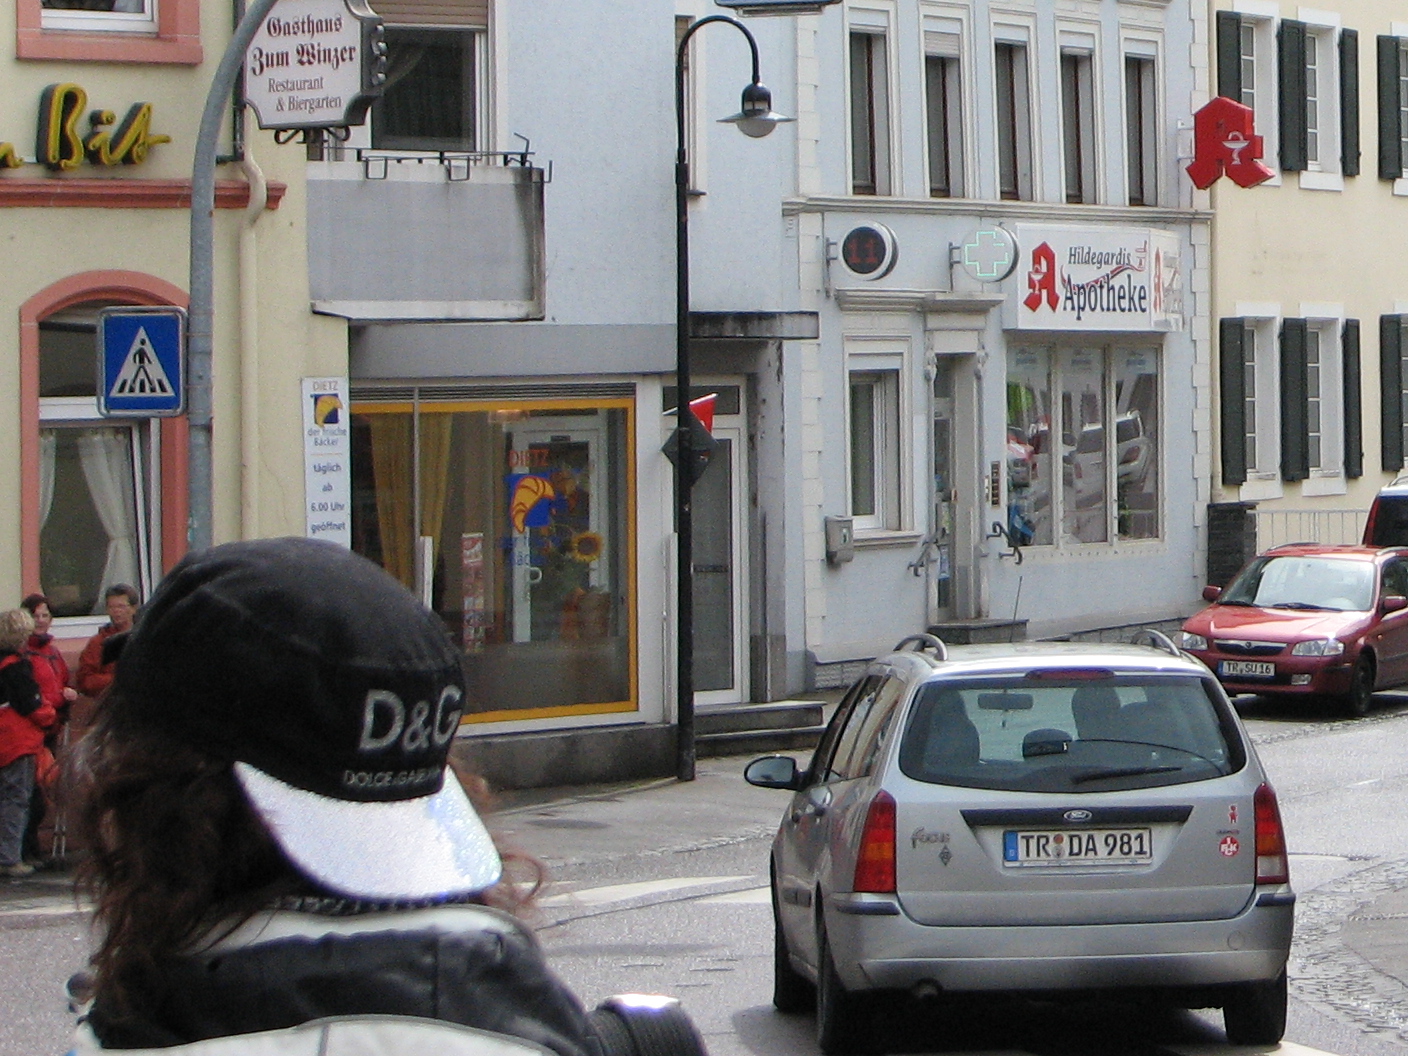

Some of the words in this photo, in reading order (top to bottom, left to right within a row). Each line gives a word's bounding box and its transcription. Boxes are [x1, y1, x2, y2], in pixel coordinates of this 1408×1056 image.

[266, 13, 343, 39] Gasthaus
[252, 46, 290, 76] Zum
[296, 42, 356, 70] Winzer
[268, 76, 324, 93] Restaurant
[276, 97, 285, 112] &
[288, 95, 342, 114] Biergarten
[848, 238, 879, 264] 11
[1068, 246, 1132, 269] Hildegardis
[1063, 274, 1147, 321] Apotheke
[313, 381, 338, 391] DIETZ
[509, 449, 550, 467] DIETZ
[313, 463, 341, 474] täglich
[322, 483, 333, 492] ab
[311, 503, 328, 512] 6.00
[331, 502, 345, 511] Uhr
[311, 522, 346, 534] geöffnet
[358, 684, 463, 751] D&G
[1021, 834, 1051, 858] TR
[1068, 834, 1098, 857] DA
[1104, 833, 1148, 856] 981
